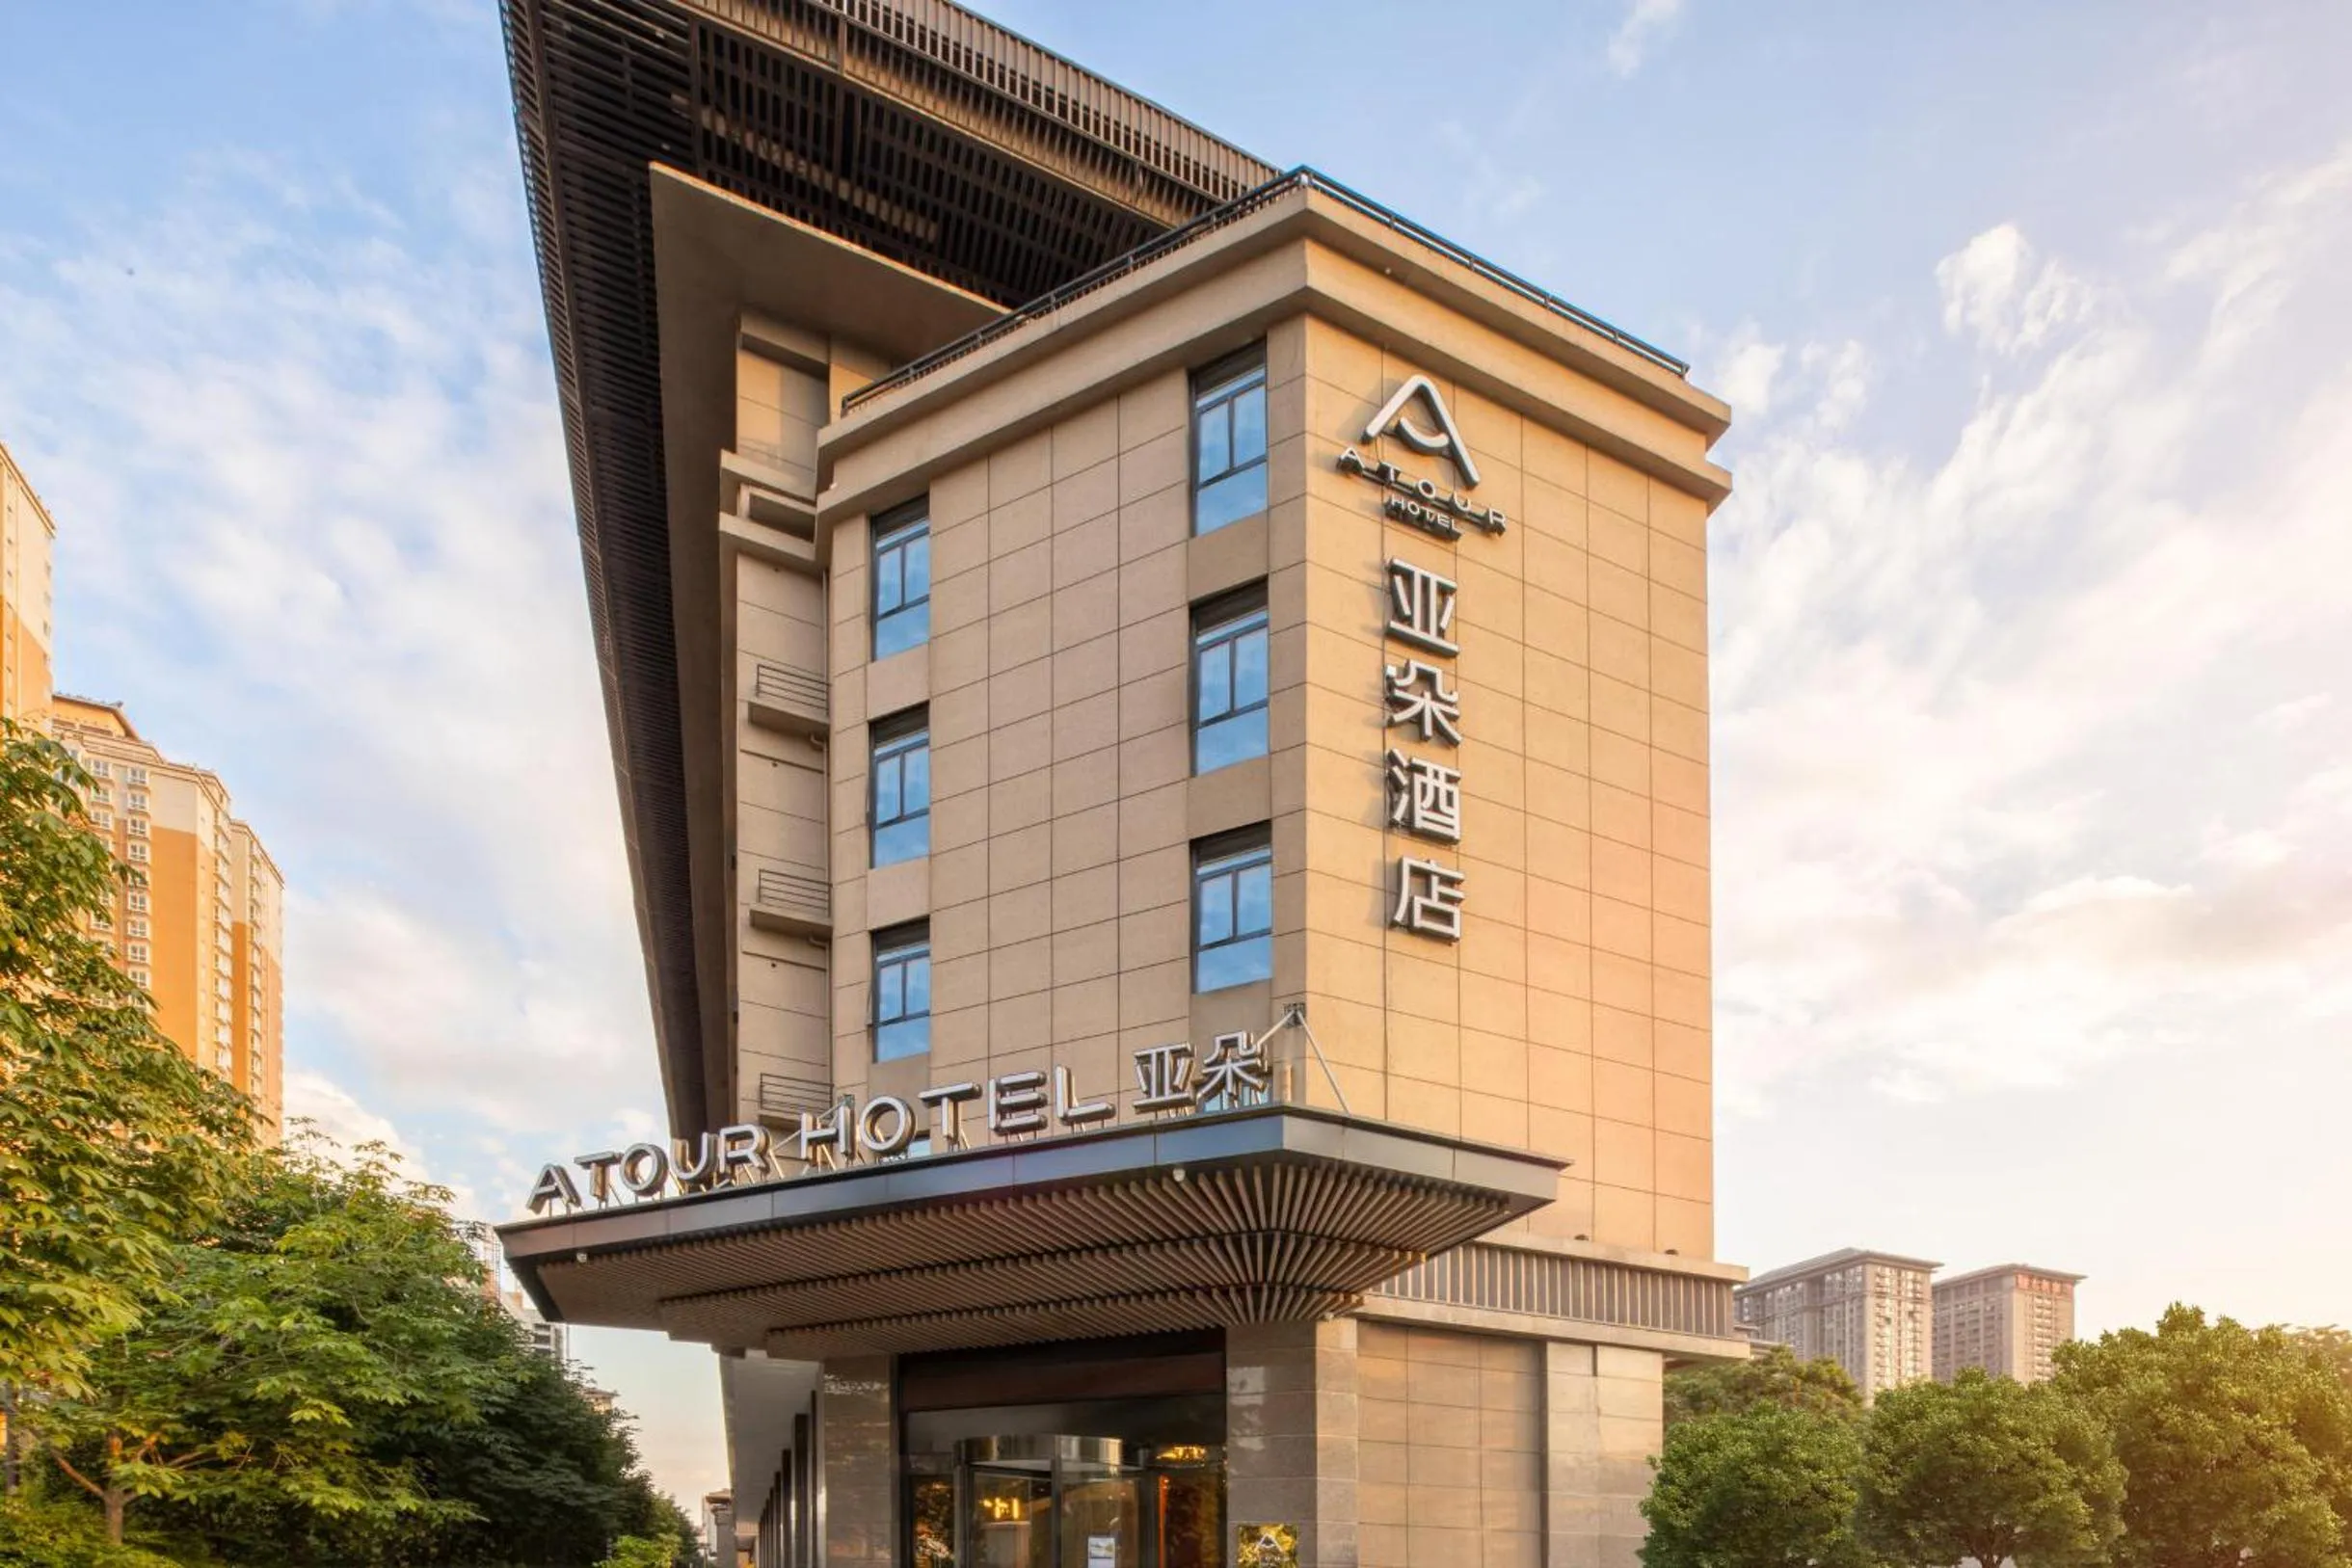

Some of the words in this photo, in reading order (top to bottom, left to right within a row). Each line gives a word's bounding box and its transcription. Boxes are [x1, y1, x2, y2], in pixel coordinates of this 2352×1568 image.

[1337, 446, 1507, 536] ATOUR
[1388, 493, 1463, 540] HOTEL
[1384, 556, 1465, 944] 亚朵酒店
[526, 1124, 773, 1215] ATOUR
[800, 1065, 1117, 1168] HOTEL
[1133, 1030, 1272, 1115] 亚朵
